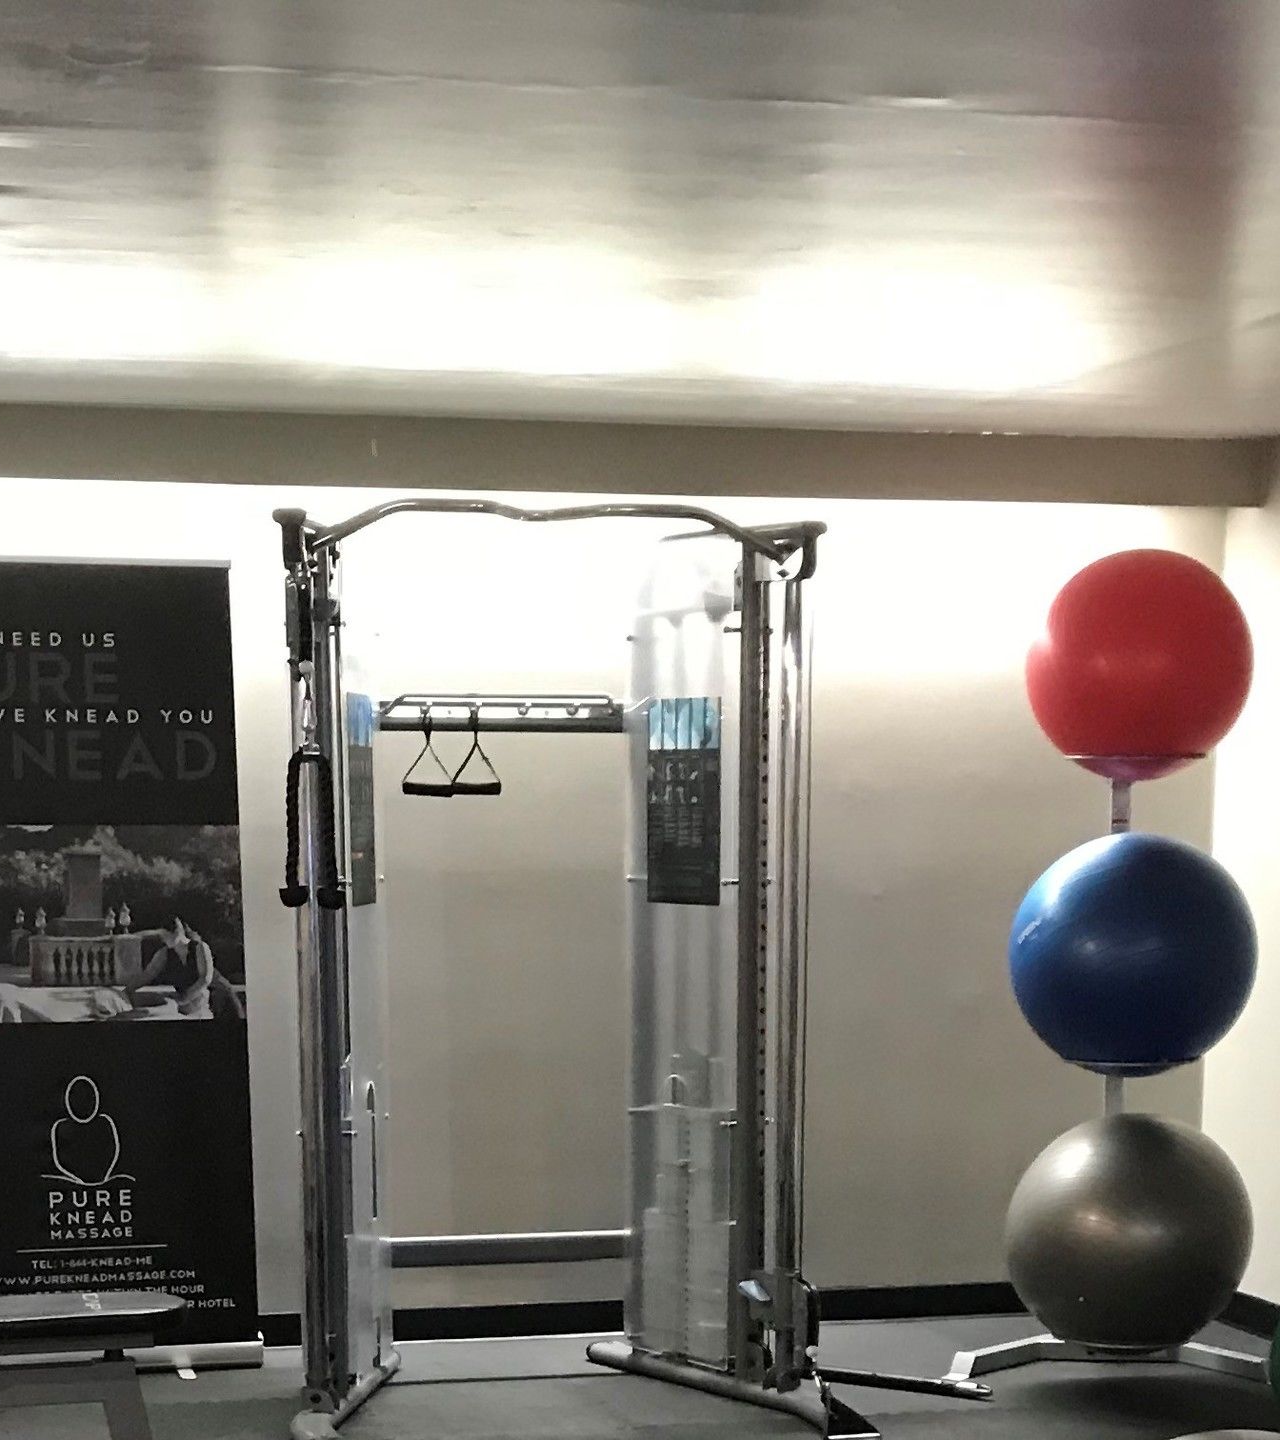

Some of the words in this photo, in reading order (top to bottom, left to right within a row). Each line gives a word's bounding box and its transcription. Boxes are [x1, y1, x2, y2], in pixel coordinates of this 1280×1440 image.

[82, 633, 115, 648] US
[45, 708, 140, 724] KNEAD
[160, 709, 214, 724] YOU
[48, 1189, 132, 1208] PURE
[50, 1210, 133, 1226] KNEAD
[50, 1226, 134, 1240] MASSAGE
[171, 1284, 205, 1294] HOUR
[198, 1298, 236, 1308] HOTEL
